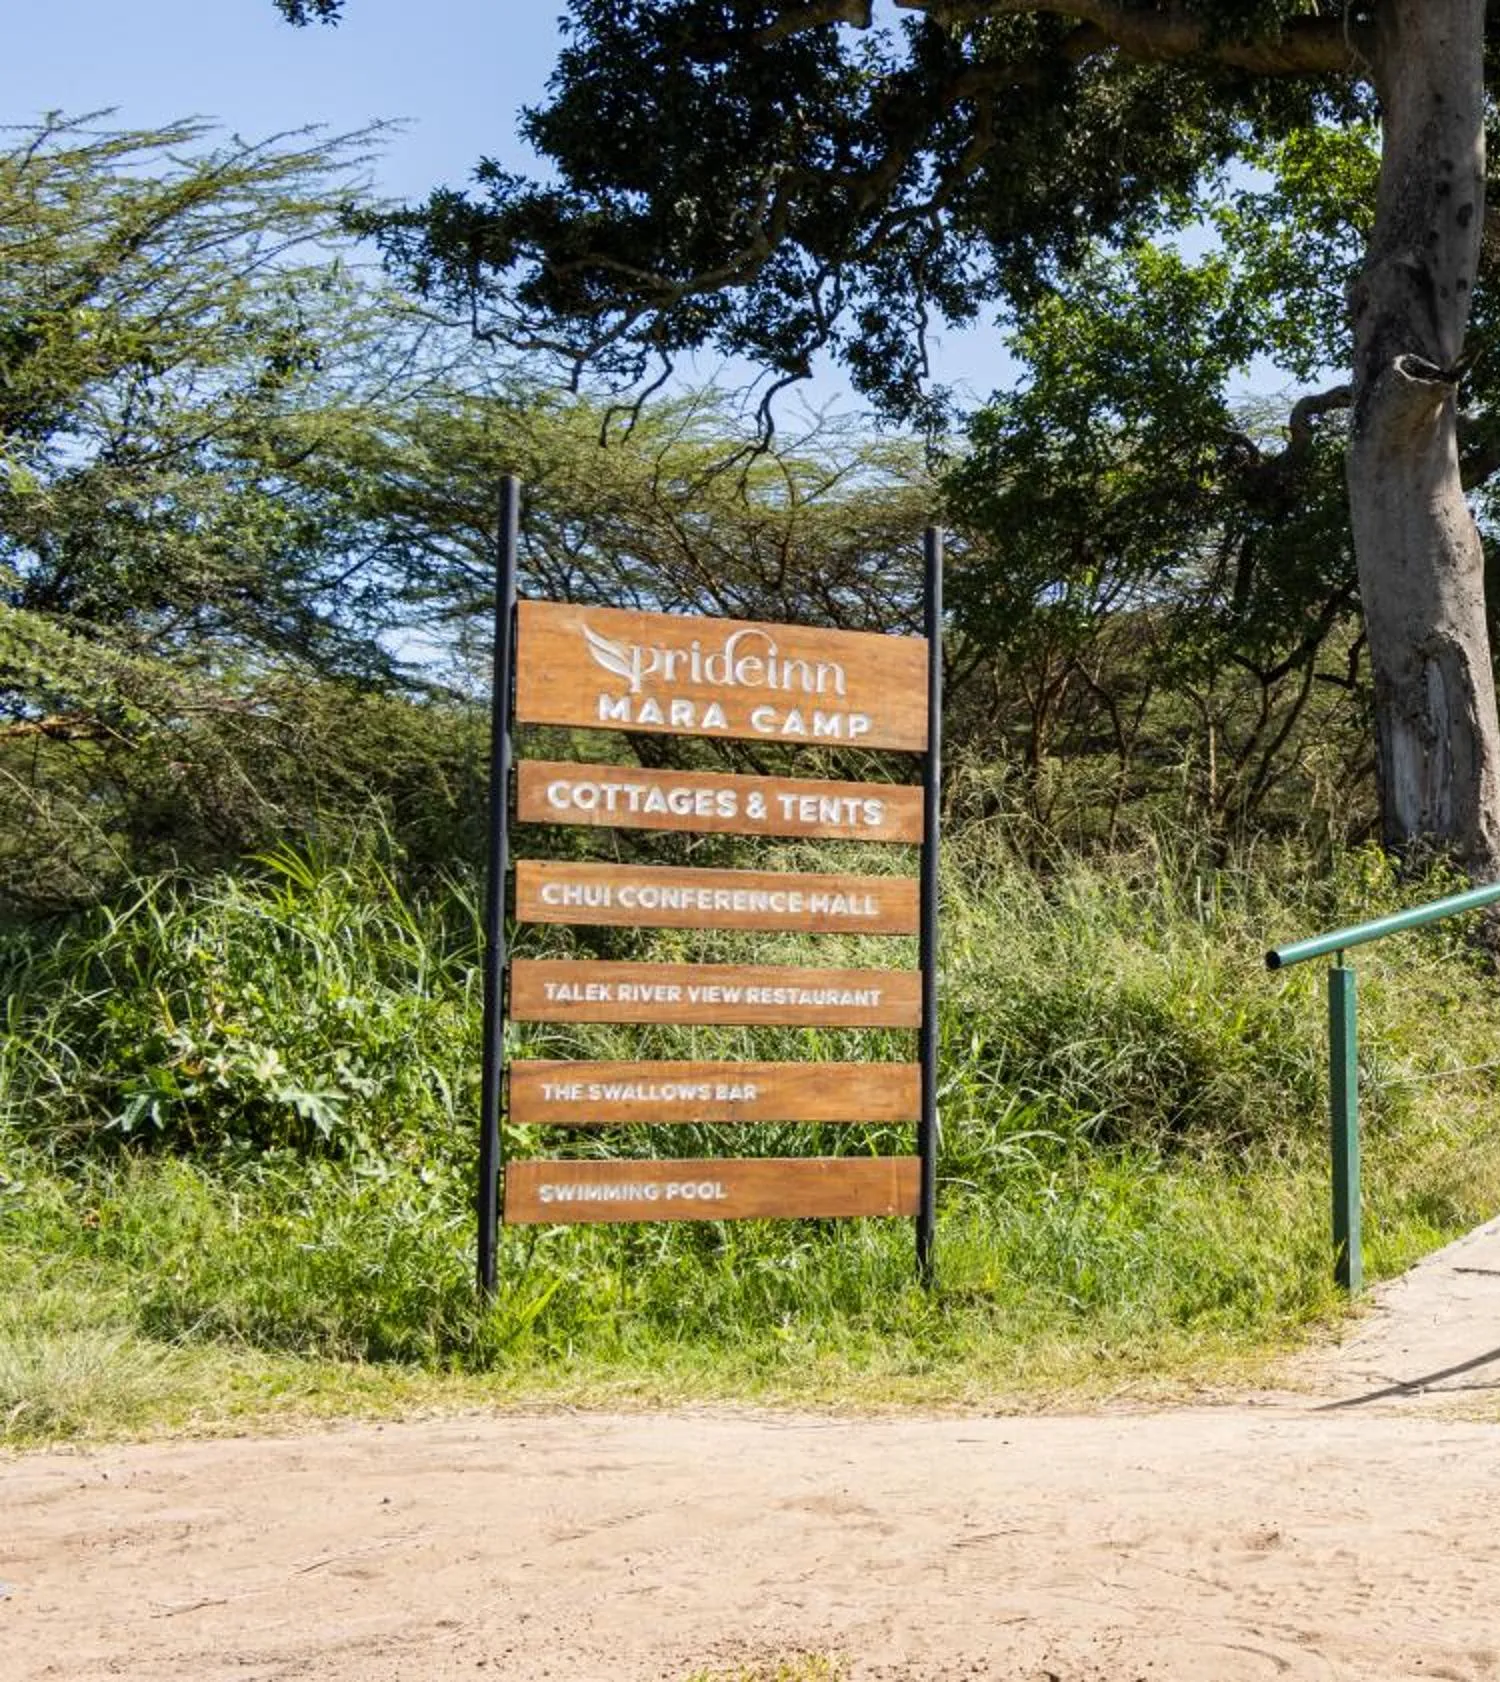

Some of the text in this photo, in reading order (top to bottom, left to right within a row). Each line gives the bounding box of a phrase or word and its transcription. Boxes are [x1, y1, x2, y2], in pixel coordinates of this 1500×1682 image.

[628, 628, 847, 695] prideinn
[598, 694, 873, 739] MARA CAMP
[546, 780, 885, 826] COTTAGES & TENTS
[541, 883, 880, 916] CHUI CONFERENCE HALL
[543, 982, 882, 1007] TALEK RIVER VIEW RESTAURANT
[541, 1083, 758, 1101] THE SWALLOWS BAR
[538, 1183, 729, 1202] SWIMMING POOL
